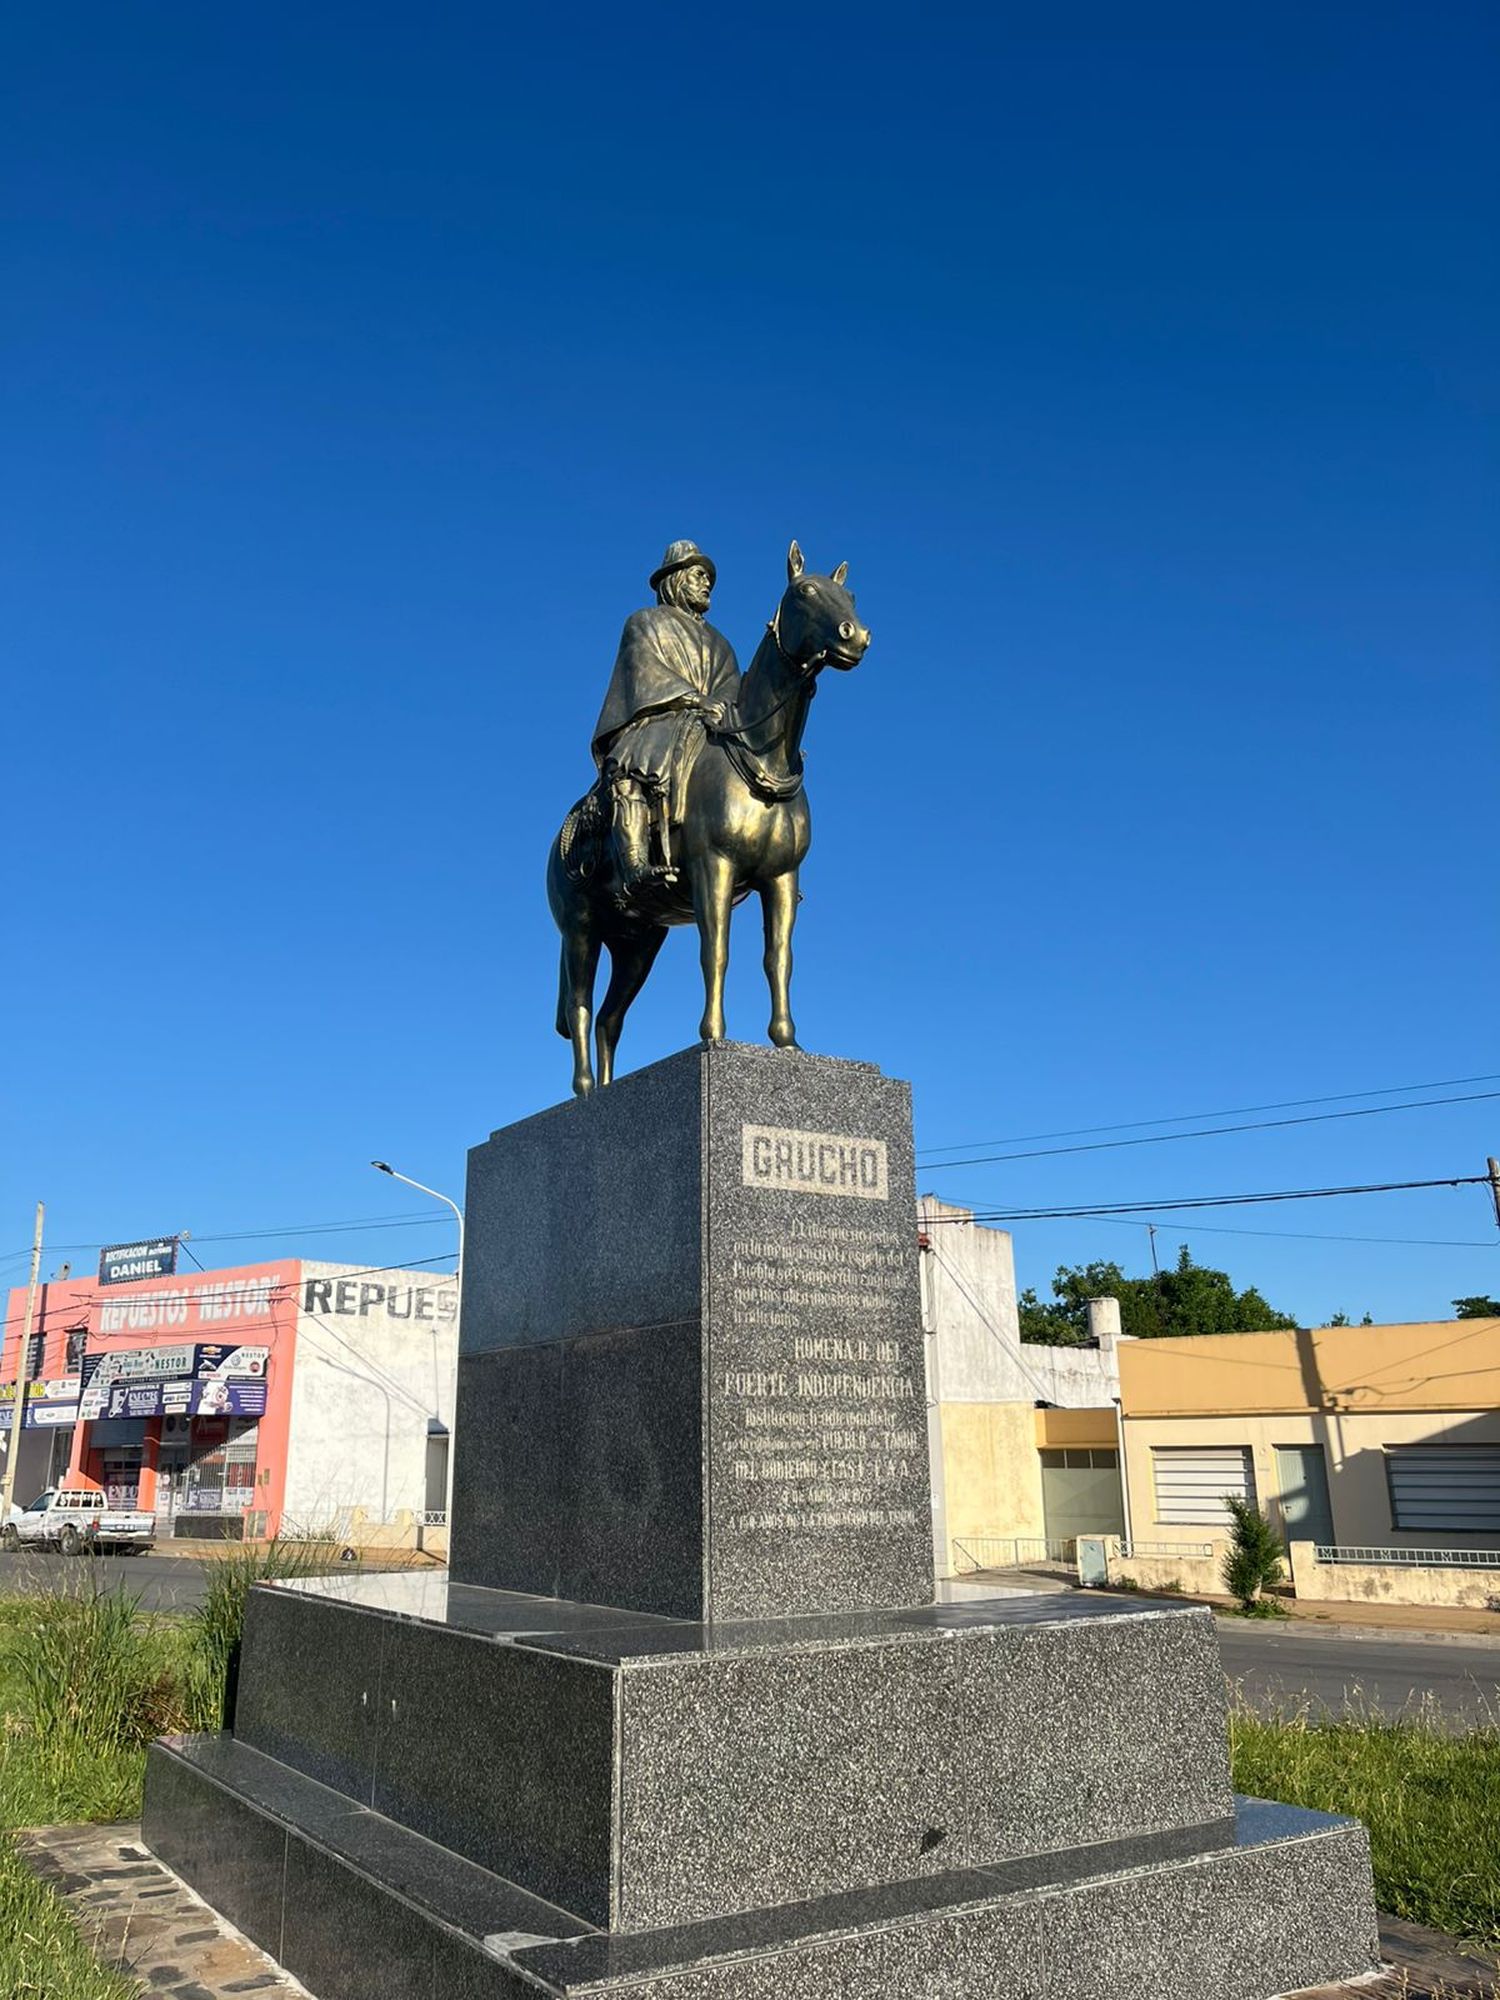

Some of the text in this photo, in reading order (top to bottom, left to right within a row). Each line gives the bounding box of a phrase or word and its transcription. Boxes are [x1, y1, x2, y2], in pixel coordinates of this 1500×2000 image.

[753, 1136, 878, 1189] GAUCHO
[110, 1259, 162, 1278] DANIEL
[100, 1288, 188, 1331] REPUESTOS
[304, 1278, 458, 1321] REPUES
[154, 1356, 186, 1370] NESTOR
[794, 1337, 900, 1362] HOMENAJE DEL
[725, 1370, 915, 1398] FUERTE INDEPENDENCIA
